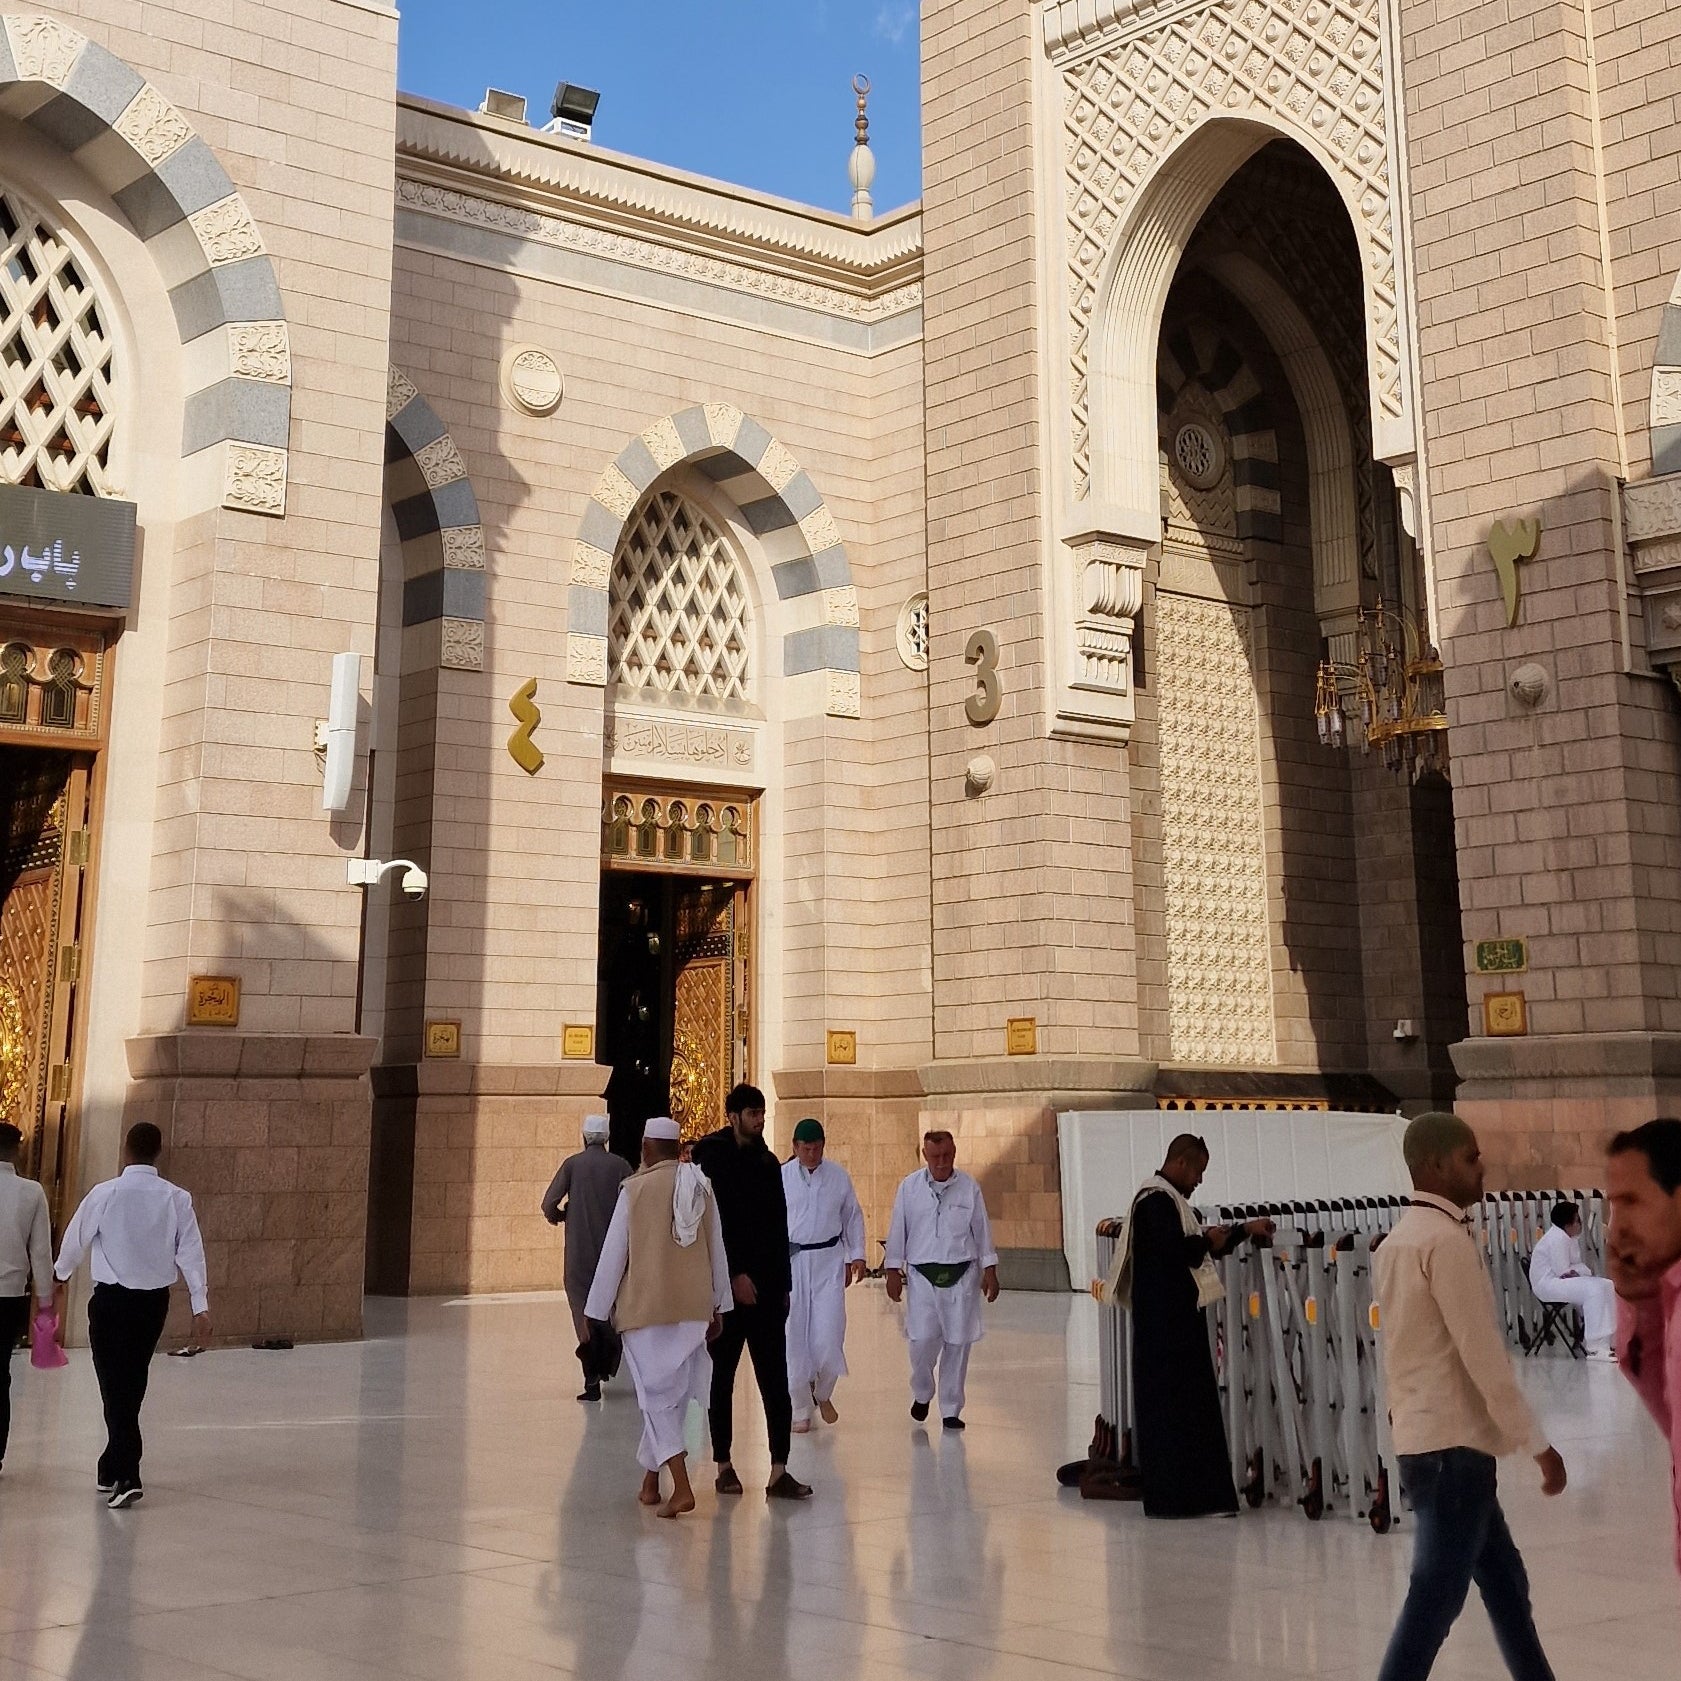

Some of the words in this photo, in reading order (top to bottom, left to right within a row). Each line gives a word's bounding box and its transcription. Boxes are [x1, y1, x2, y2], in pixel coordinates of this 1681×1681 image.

[21, 538, 80, 590] باب
[1487, 518, 1540, 628] ٣
[507, 677, 545, 776] ٤
[965, 630, 1001, 727] 3
